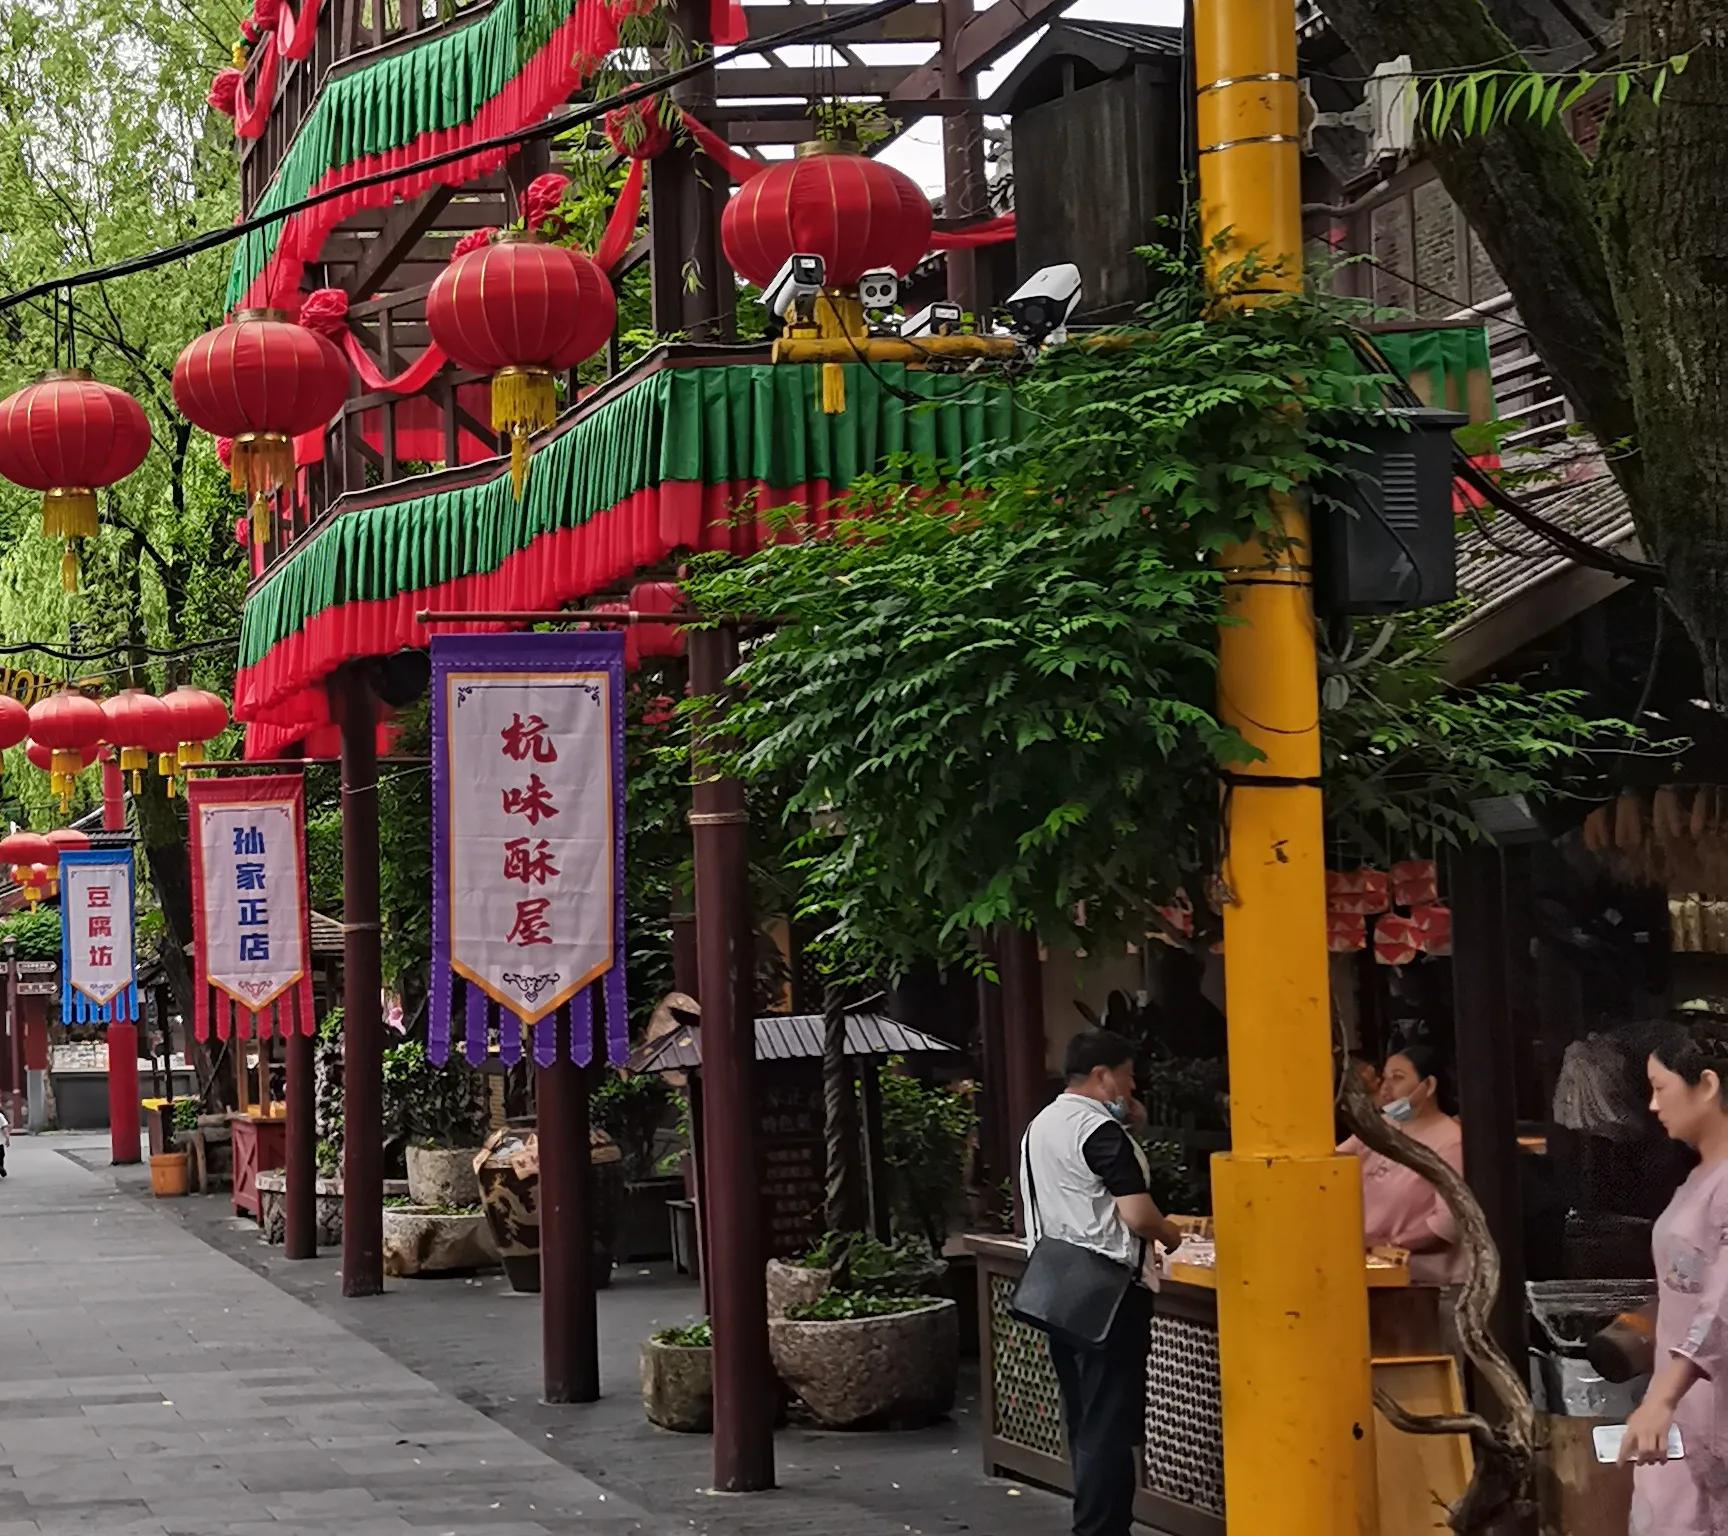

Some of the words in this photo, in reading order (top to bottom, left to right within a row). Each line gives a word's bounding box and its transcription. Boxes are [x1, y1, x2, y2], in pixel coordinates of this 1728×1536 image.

[233, 826, 270, 962] 孙家正店
[501, 713, 560, 948] 杭味酥屋
[87, 886, 112, 967] 豆腐坊
